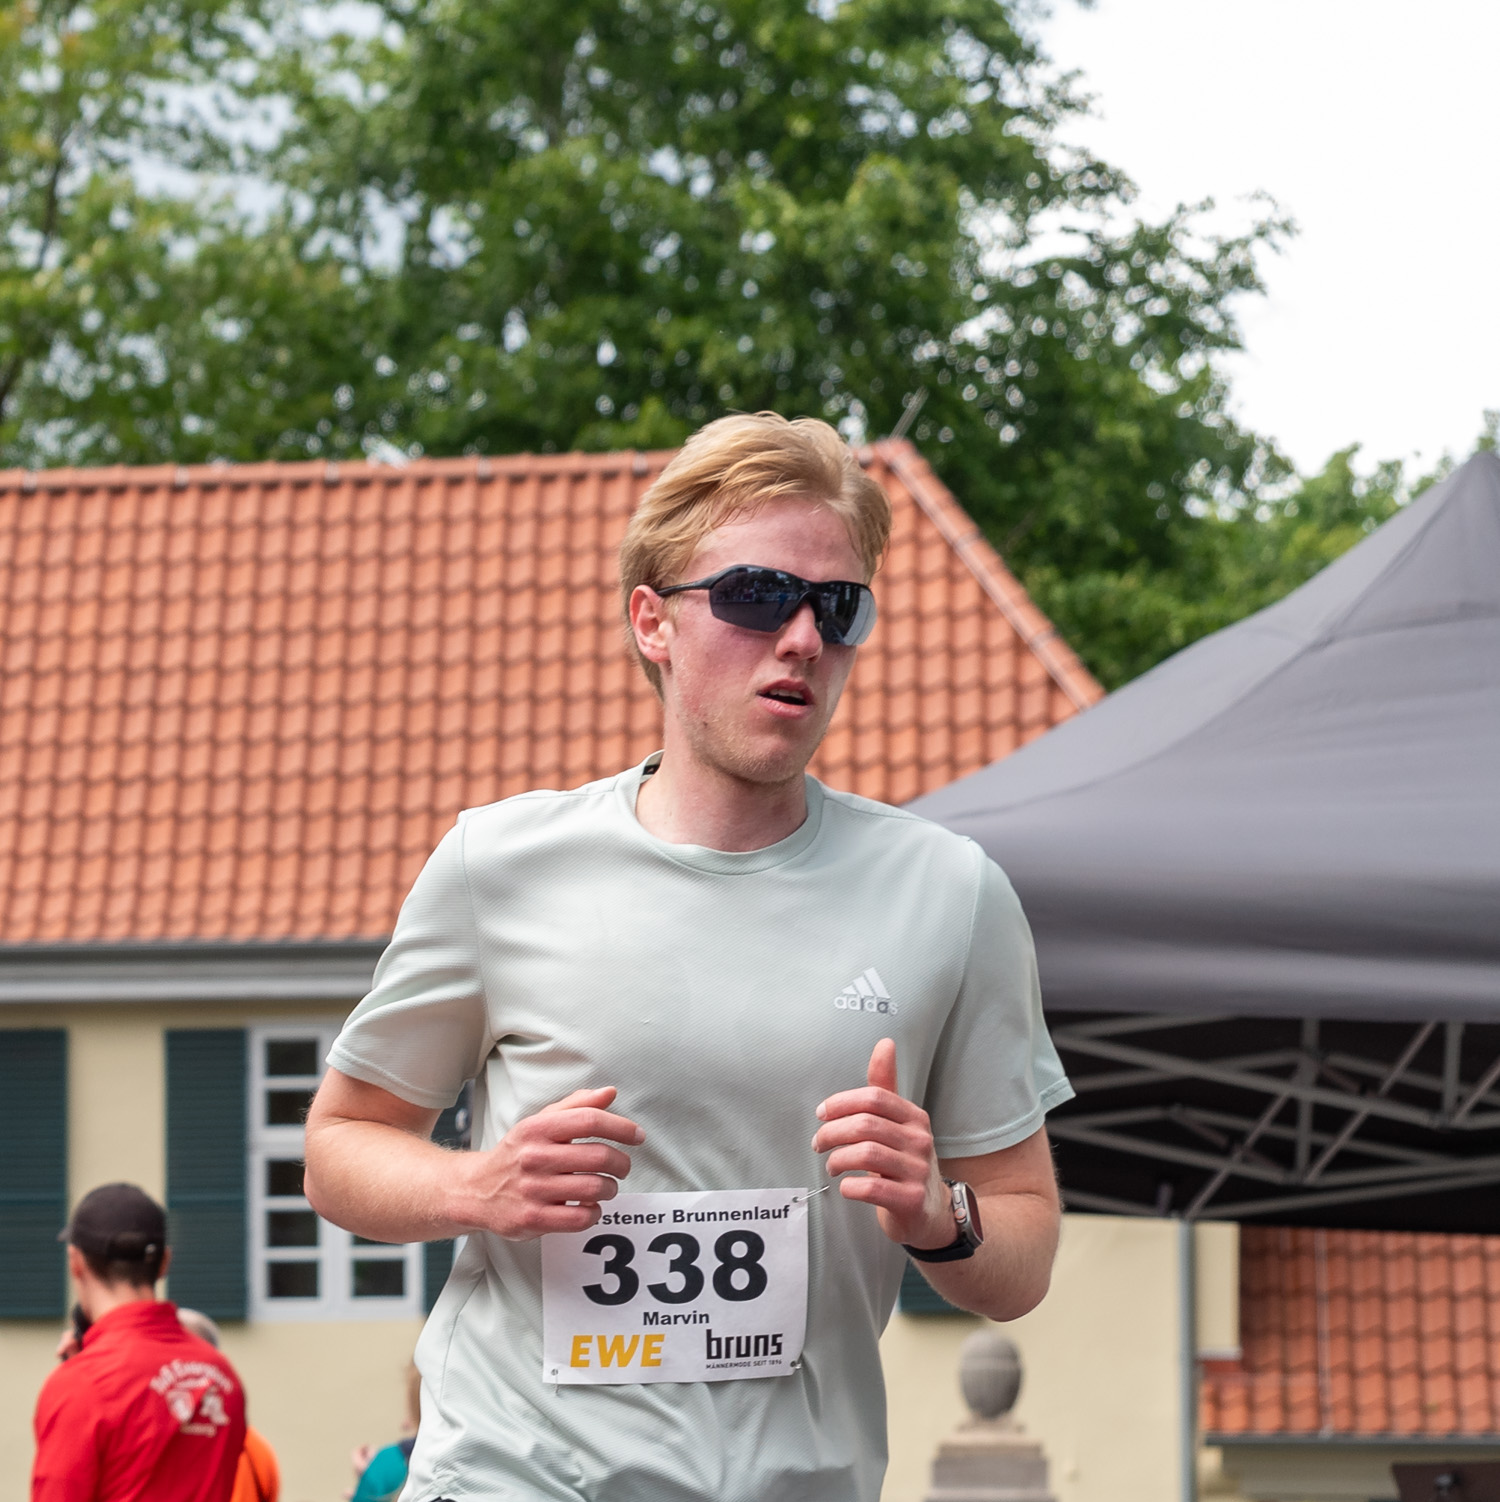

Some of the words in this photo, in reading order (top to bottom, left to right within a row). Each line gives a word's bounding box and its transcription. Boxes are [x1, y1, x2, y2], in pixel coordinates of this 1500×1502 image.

[834, 994, 898, 1015] adidas
[594, 1211, 666, 1226] stener
[672, 1204, 790, 1223] Brunnenlauf
[582, 1230, 768, 1306] 338
[643, 1310, 710, 1326] Marvin
[570, 1334, 666, 1368] EWE
[706, 1329, 783, 1359] bruns
[706, 1361, 751, 1369] MÄNNERMODE
